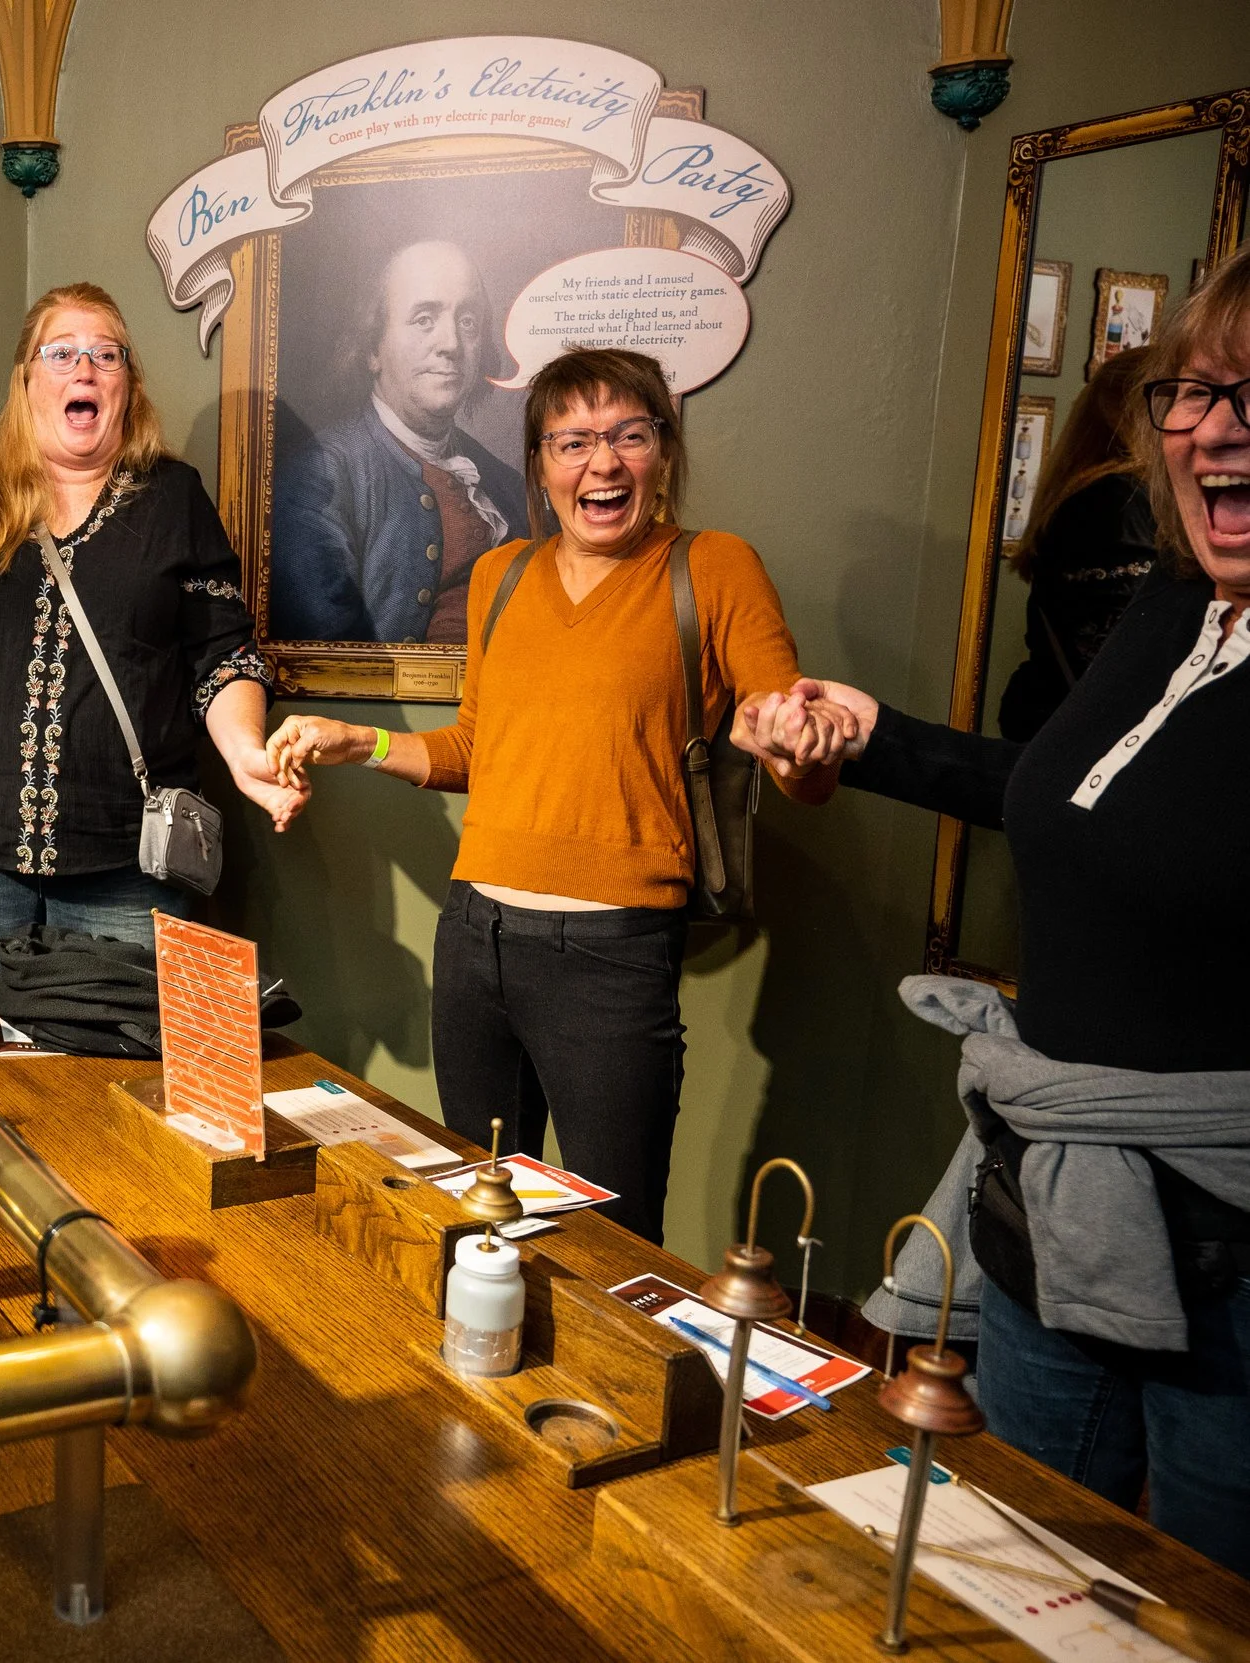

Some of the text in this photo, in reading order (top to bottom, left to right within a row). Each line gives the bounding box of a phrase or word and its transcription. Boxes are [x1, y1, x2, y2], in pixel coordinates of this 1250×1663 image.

[329, 108, 572, 146] Come play with my electric parlor games!
[178, 57, 774, 246] Ben Franklin's Electricity Party
[562, 272, 694, 290] My friends and I amused
[528, 287, 727, 303] ourselves with static electricity games.
[554, 306, 698, 322] The tricks delighted us, and
[528, 319, 722, 335] demonstrated what I had learned about
[561, 333, 687, 347] the nature of electricity.
